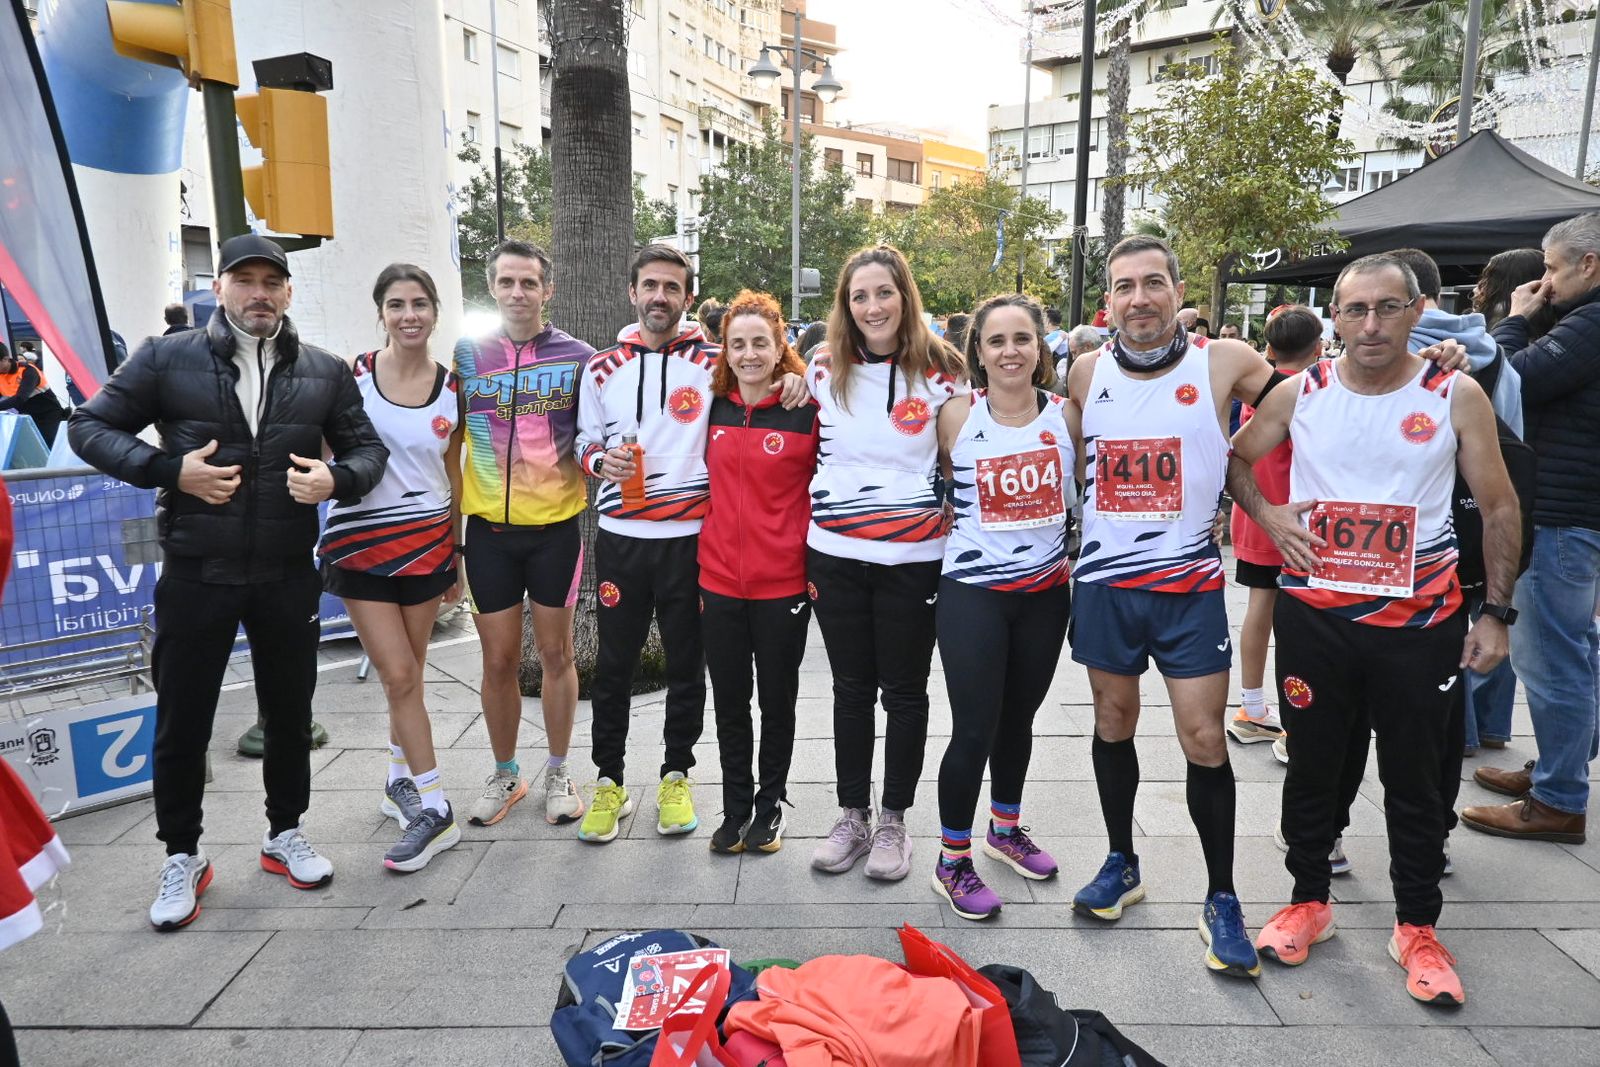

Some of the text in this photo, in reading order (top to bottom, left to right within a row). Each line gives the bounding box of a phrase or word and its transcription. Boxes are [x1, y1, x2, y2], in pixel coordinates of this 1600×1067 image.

[981, 460, 1059, 497] 1604
[1098, 452, 1177, 482] 1410
[1314, 515, 1408, 553] 1670
[1333, 550, 1358, 558] MANUEL
[1354, 559, 1396, 569] GONZALEZ
[96, 715, 147, 779] 2
